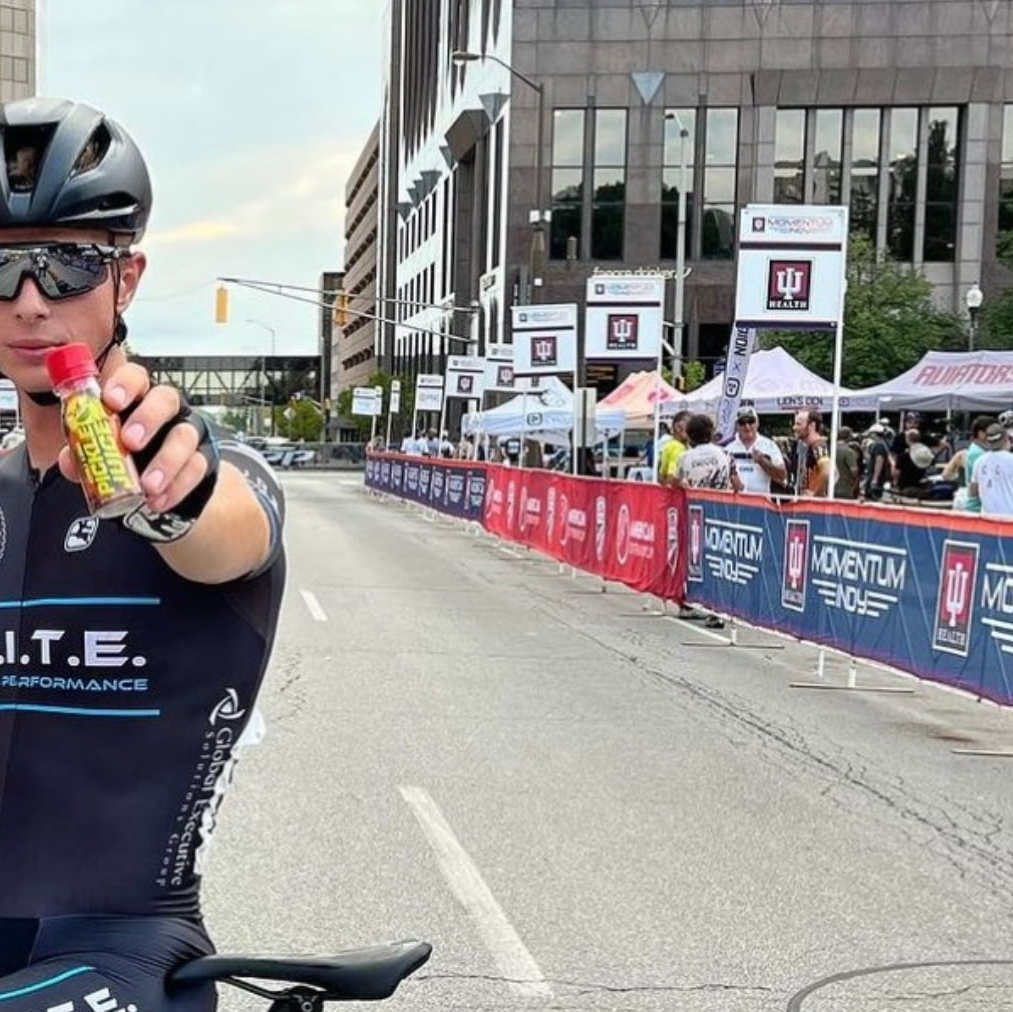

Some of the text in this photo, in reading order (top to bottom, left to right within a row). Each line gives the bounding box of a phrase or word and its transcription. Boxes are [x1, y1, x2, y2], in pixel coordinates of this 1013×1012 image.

[769, 300, 807, 309] HEALTH
[77, 424, 115, 497] PICKLE
[94, 418, 135, 490] JUICE
[705, 526, 763, 562] MOMENTUM
[811, 543, 907, 590] MOMENTUM
[2, 675, 149, 691] PERFORMANCE
[202, 727, 233, 792] Global
[171, 799, 210, 886] Executive
